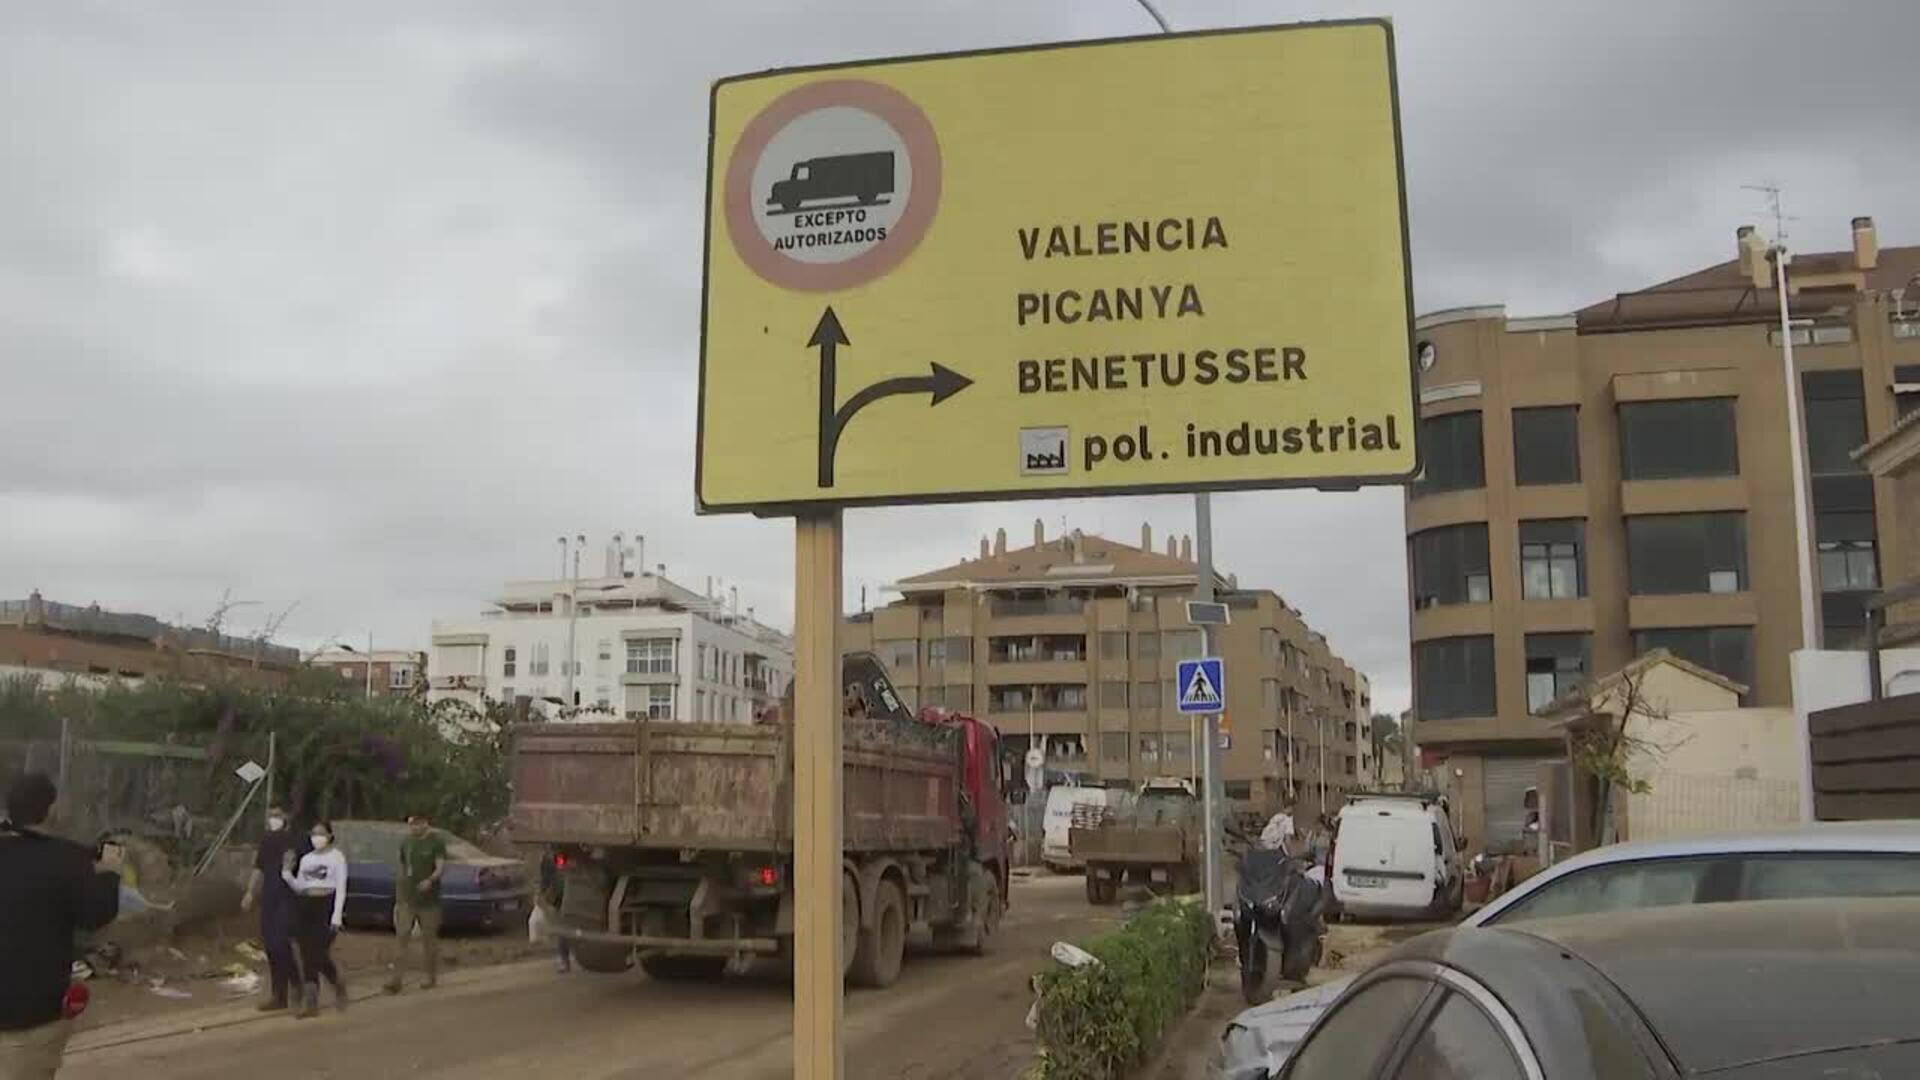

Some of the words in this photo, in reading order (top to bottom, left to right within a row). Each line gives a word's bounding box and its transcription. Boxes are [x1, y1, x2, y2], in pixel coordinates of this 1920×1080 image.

[774, 227, 887, 250] AUTORIZADOS
[794, 209, 866, 228] EXCEPTO
[1018, 216, 1228, 259] VALENCIA
[1017, 284, 1205, 325] PICANYA
[1017, 347, 1308, 394] BENETUSSER
[1084, 425, 1169, 471] pol.
[1186, 414, 1401, 457] industrial
